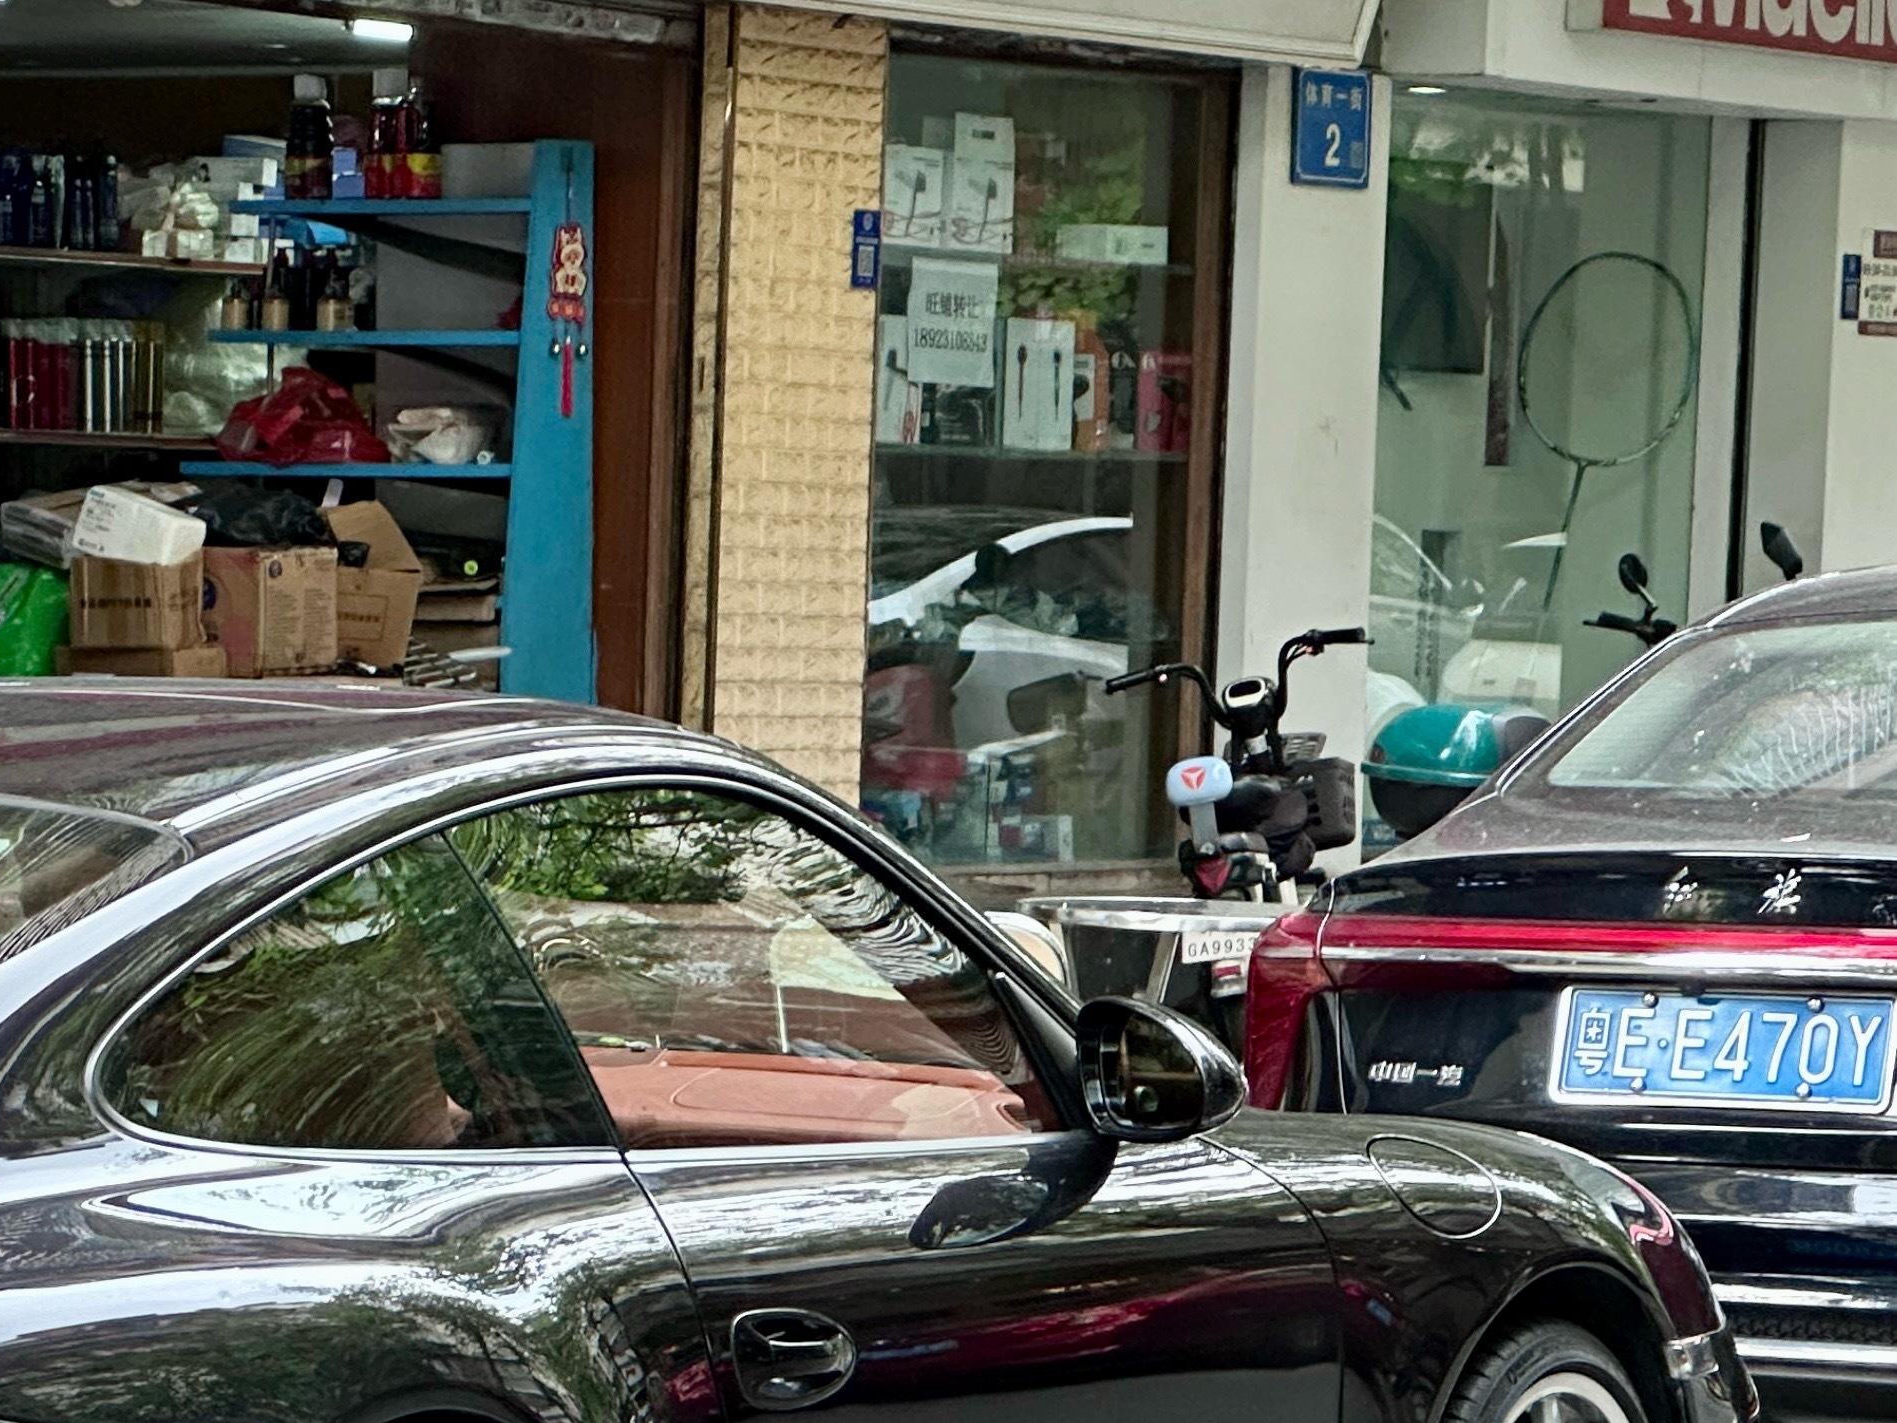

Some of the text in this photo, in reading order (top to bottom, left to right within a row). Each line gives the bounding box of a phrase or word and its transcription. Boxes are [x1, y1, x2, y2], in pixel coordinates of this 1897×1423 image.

[1324, 123, 1341, 168] 2
[1368, 1061, 1464, 1086] 中国一汽
